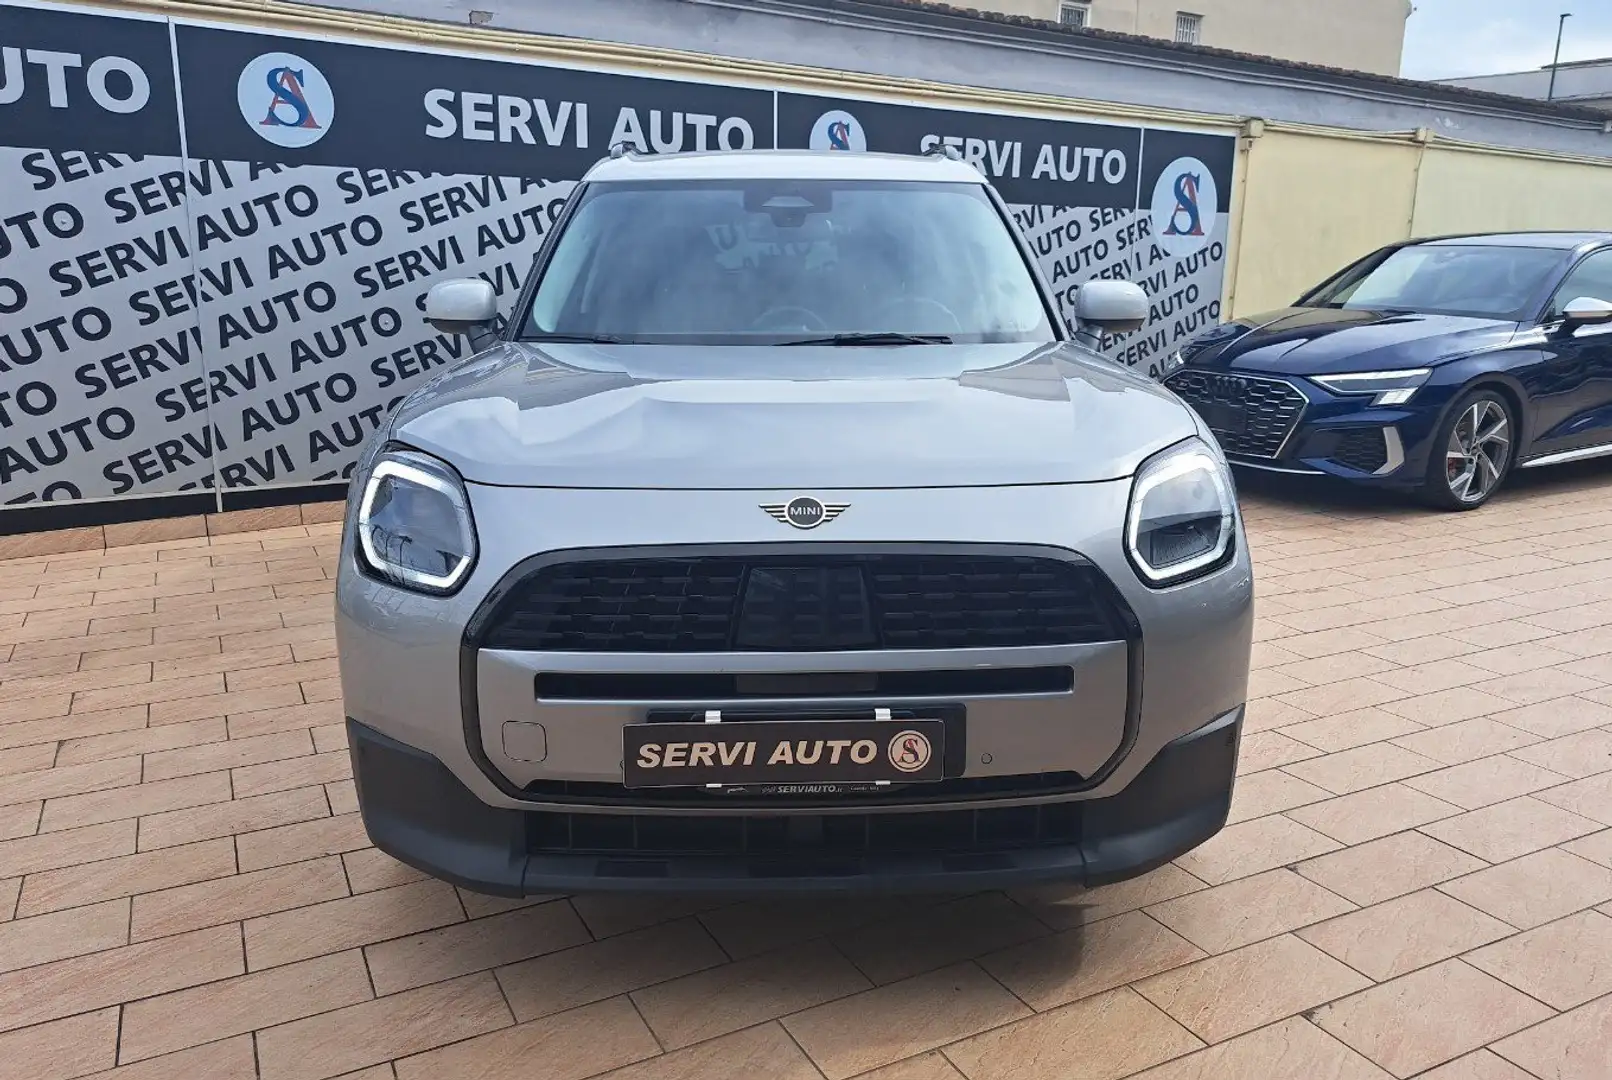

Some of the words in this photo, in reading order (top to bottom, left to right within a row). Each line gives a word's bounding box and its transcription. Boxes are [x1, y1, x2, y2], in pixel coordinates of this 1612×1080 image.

[0, 47, 150, 113] TO
[424, 88, 588, 149] SERVI
[608, 107, 754, 153] AUTO
[21, 150, 146, 190] SER
[1031, 144, 1126, 184] AUTO
[0, 202, 84, 259] TO
[104, 160, 233, 224] SERVI
[49, 226, 189, 298] SERVI
[197, 185, 319, 251] AUTO
[336, 168, 432, 204] SER
[1028, 220, 1081, 259] UTO
[128, 256, 254, 326] SERVI
[268, 214, 383, 280] AUTO
[400, 175, 508, 233] SERVI
[1053, 239, 1108, 284] AUTO
[1174, 241, 1223, 283] AUTO
[75, 325, 203, 399] SERVI
[218, 289, 337, 349] AUTO
[353, 235, 465, 298] SERVI
[1116, 329, 1167, 367] SERVI
[1173, 300, 1221, 342] AUTO
[1149, 284, 1199, 326] AUTO
[0, 406, 135, 484] AUTO
[156, 352, 277, 422] SERVI
[290, 306, 402, 373] AUTO
[103, 420, 228, 494] SERVI
[241, 372, 357, 442] AUTO
[370, 333, 462, 388] SERV
[309, 396, 406, 463] AUT
[790, 506, 821, 516] MINI
[637, 741, 756, 768] SERVI
[767, 739, 878, 765] AUTO
